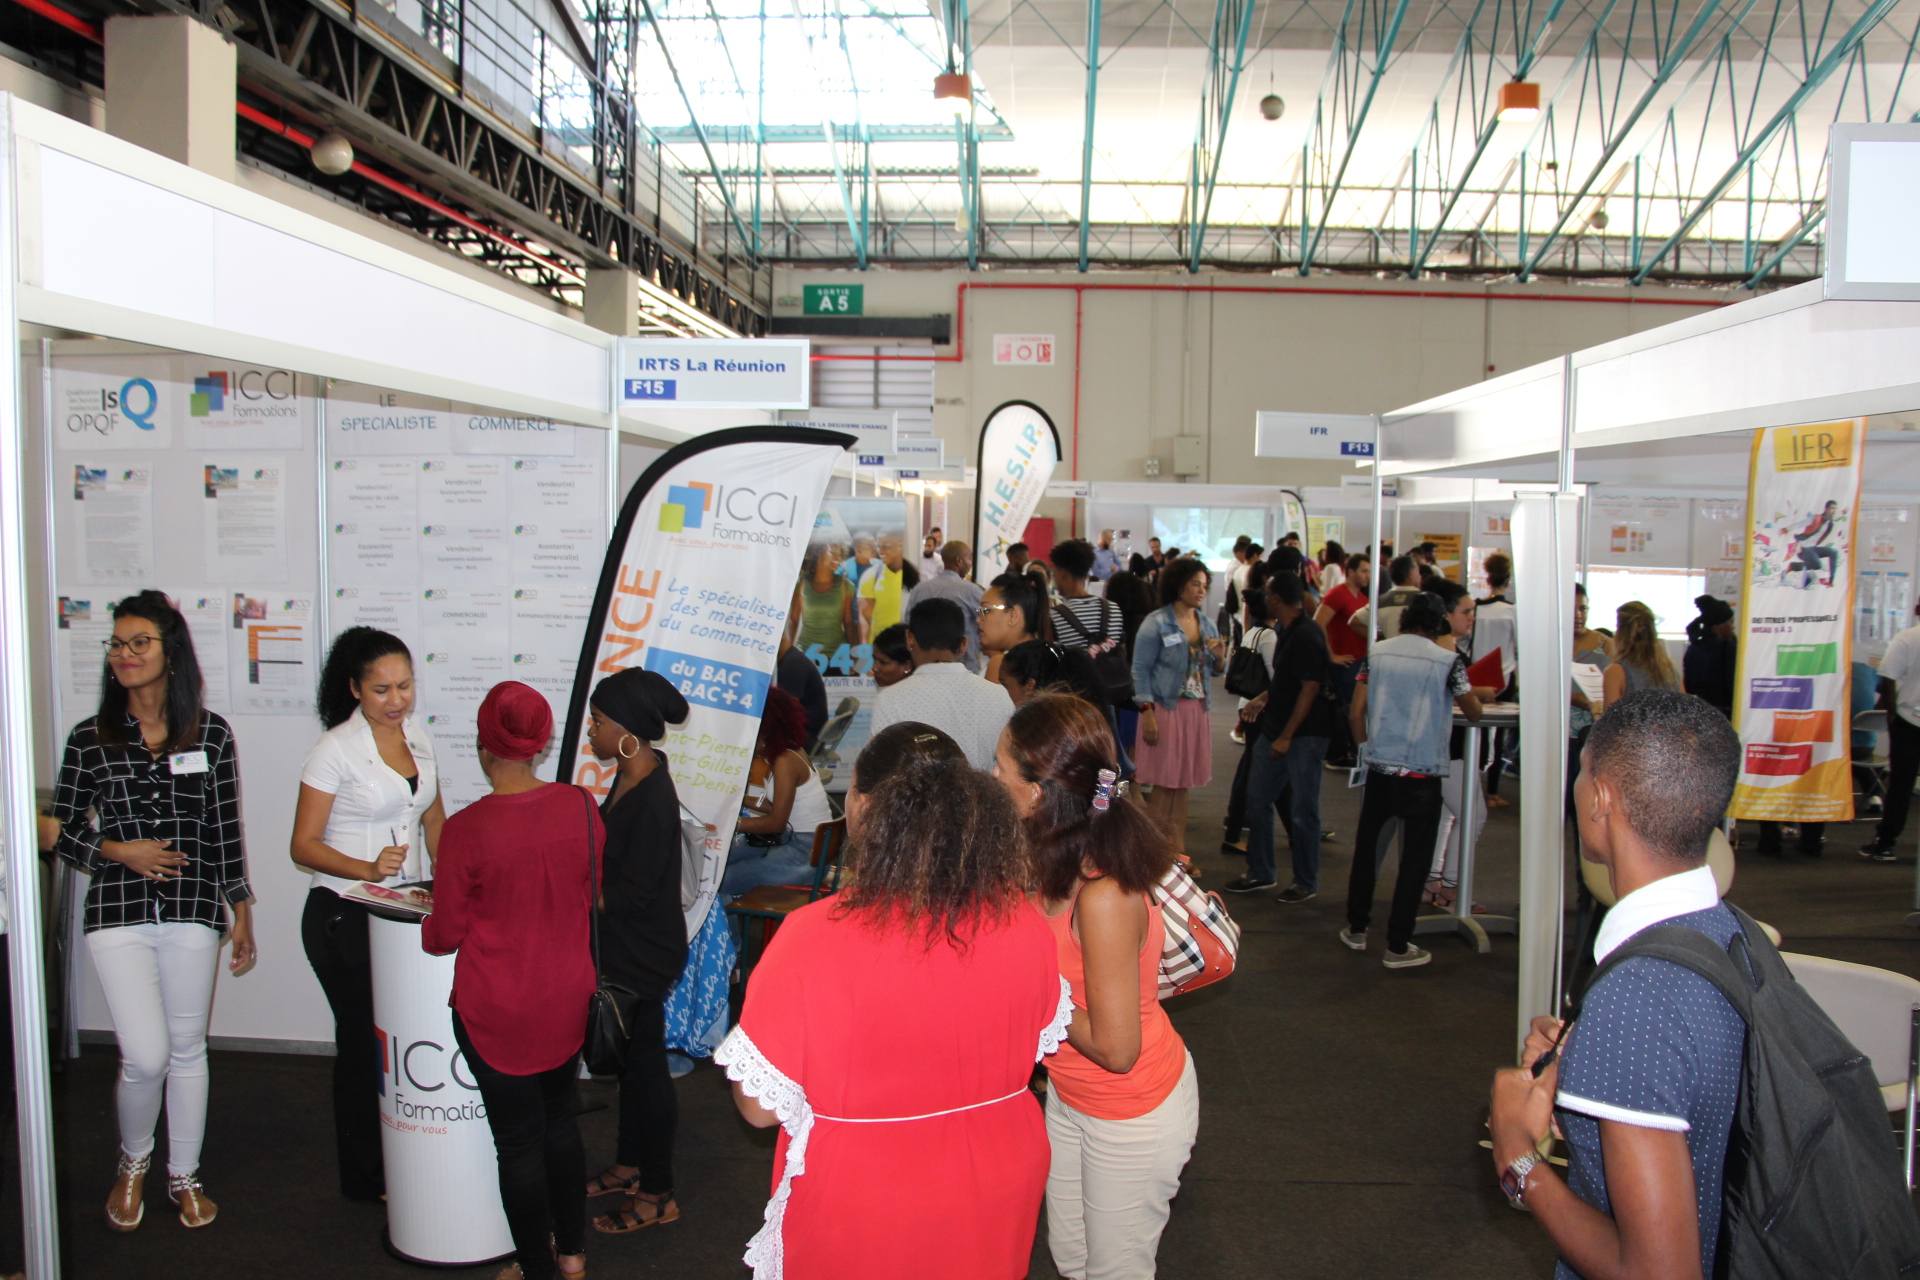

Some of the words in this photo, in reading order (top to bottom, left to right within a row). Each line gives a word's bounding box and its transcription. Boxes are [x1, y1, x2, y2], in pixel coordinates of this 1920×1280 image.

[817, 288, 850, 296] SORTIE
[639, 358, 681, 371] IRTS
[687, 359, 708, 371] La
[714, 358, 786, 373] Réunion
[232, 370, 297, 400] ICCI
[631, 380, 665, 395] F15
[379, 393, 396, 407] LE
[233, 404, 297, 418] Formations
[67, 413, 120, 435] OPQF
[341, 415, 438, 431] SPECIALISTE
[468, 416, 557, 431] COMMERCE
[1310, 427, 1328, 436] IFR
[1347, 442, 1370, 453] F13
[1791, 429, 1836, 462] IFR
[862, 456, 879, 464] F17
[715, 485, 799, 529] ICCI
[712, 522, 791, 548] Formations
[669, 536, 687, 545] Avez
[711, 541, 729, 550] pour
[667, 577, 689, 596] Le
[698, 587, 786, 622] spécialiste
[670, 597, 699, 617] des
[708, 609, 775, 636] métiers
[659, 614, 682, 631] du
[690, 622, 776, 655] commerce
[670, 659, 696, 678] du
[701, 664, 742, 688] BAC
[397, 1121, 419, 1132] pour
[422, 1126, 448, 1135] vous
